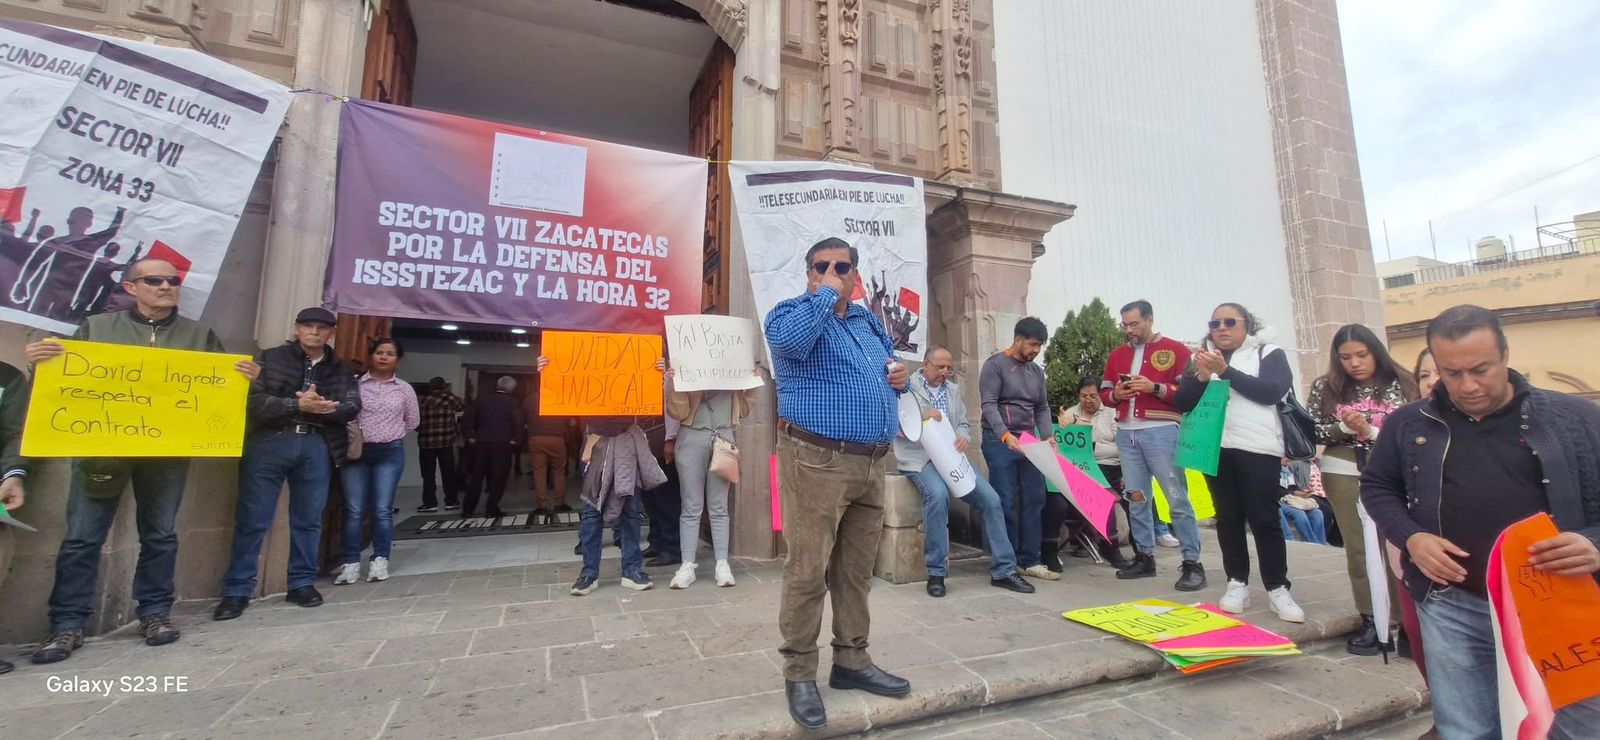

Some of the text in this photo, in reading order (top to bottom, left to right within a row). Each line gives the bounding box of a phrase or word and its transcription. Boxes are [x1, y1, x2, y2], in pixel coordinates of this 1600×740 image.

[84, 67, 113, 91] EN
[113, 78, 142, 101] PIE
[142, 87, 167, 109] DE
[167, 96, 231, 131] LUCHA!!
[56, 105, 185, 168] SECTOR VII
[58, 156, 155, 202] ZONA 33
[838, 189, 848, 202] EN
[849, 190, 862, 204] PIE
[864, 191, 875, 203] DE
[875, 192, 905, 206] LUCHA!!
[379, 200, 669, 257] SECTOR VII ZACATECAS
[882, 220, 895, 237] VII
[387, 231, 657, 283] POR LA DEFENSA DEL
[352, 258, 670, 310] ISSSTEZAC Y LA HORA 32
[62, 351, 226, 394] David Ingrato
[554, 335, 657, 373] UNIDAD
[59, 384, 199, 412] respeta el
[544, 373, 661, 408] SINDICAL
[50, 406, 162, 438] Contrato
